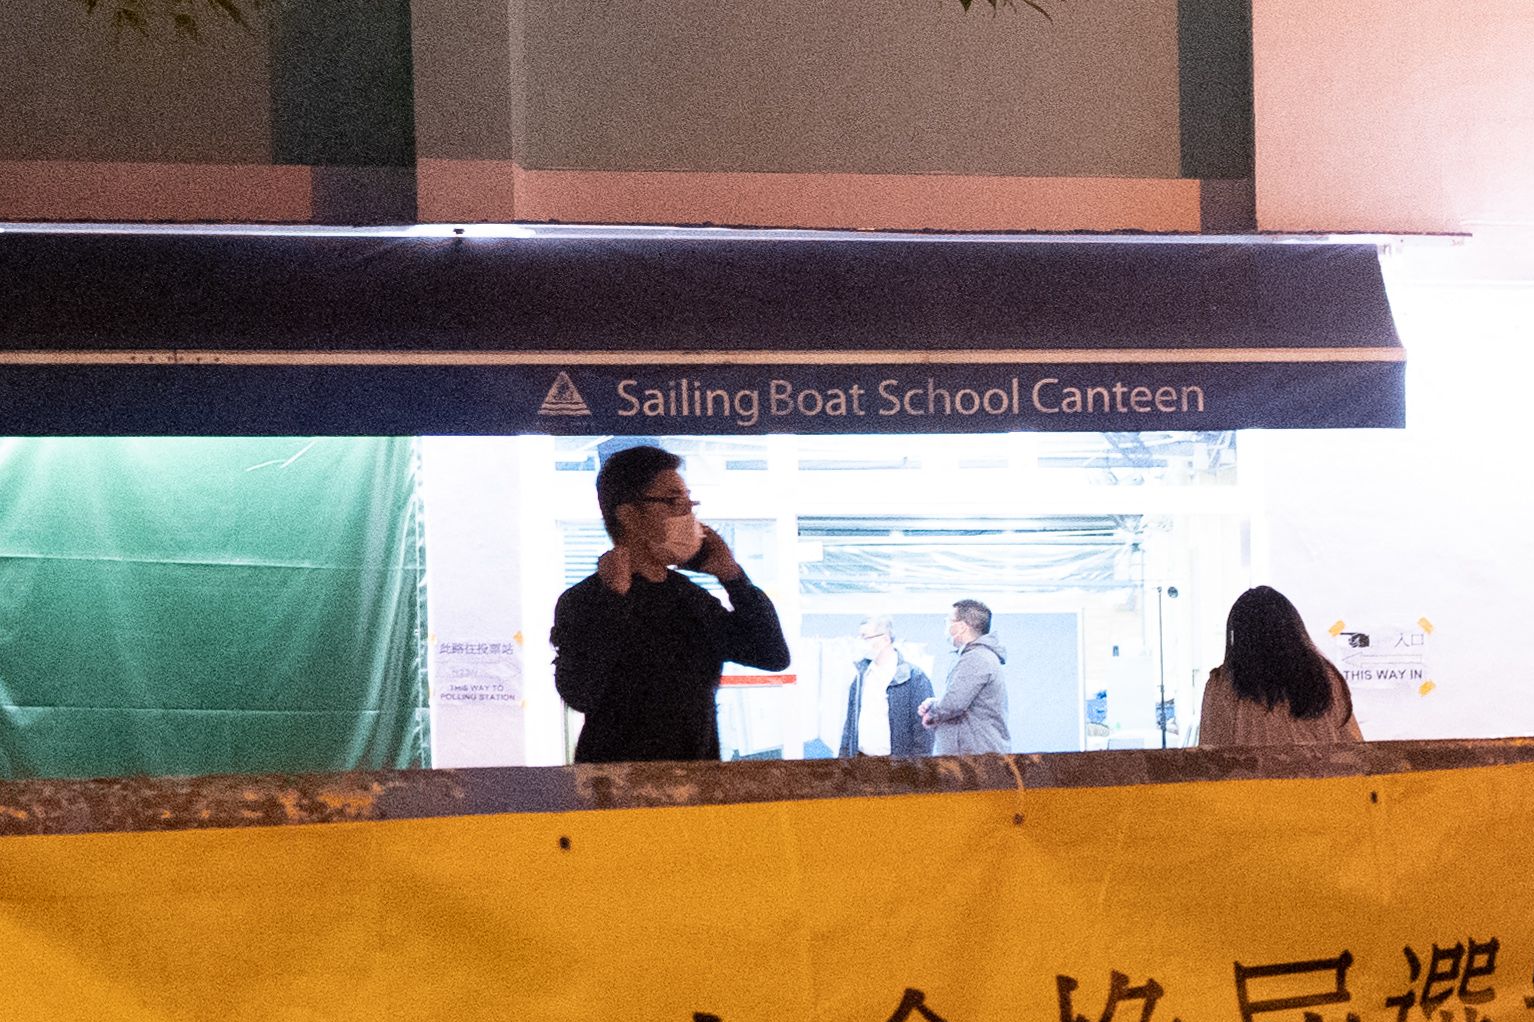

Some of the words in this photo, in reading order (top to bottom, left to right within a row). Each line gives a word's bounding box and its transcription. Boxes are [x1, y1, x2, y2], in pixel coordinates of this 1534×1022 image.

[617, 379, 759, 426] Sailing
[770, 380, 866, 416] Boat
[878, 378, 1019, 415] School
[1032, 377, 1206, 413] Canteen
[1395, 633, 1425, 647] 入口
[1344, 670, 1372, 681] THIS
[1376, 669, 1406, 680] WAY
[1410, 668, 1423, 680] IN
[471, 684, 489, 692] WAY
[493, 684, 505, 692] TO
[440, 693, 477, 701] POLLING
[479, 693, 516, 701] STATION
